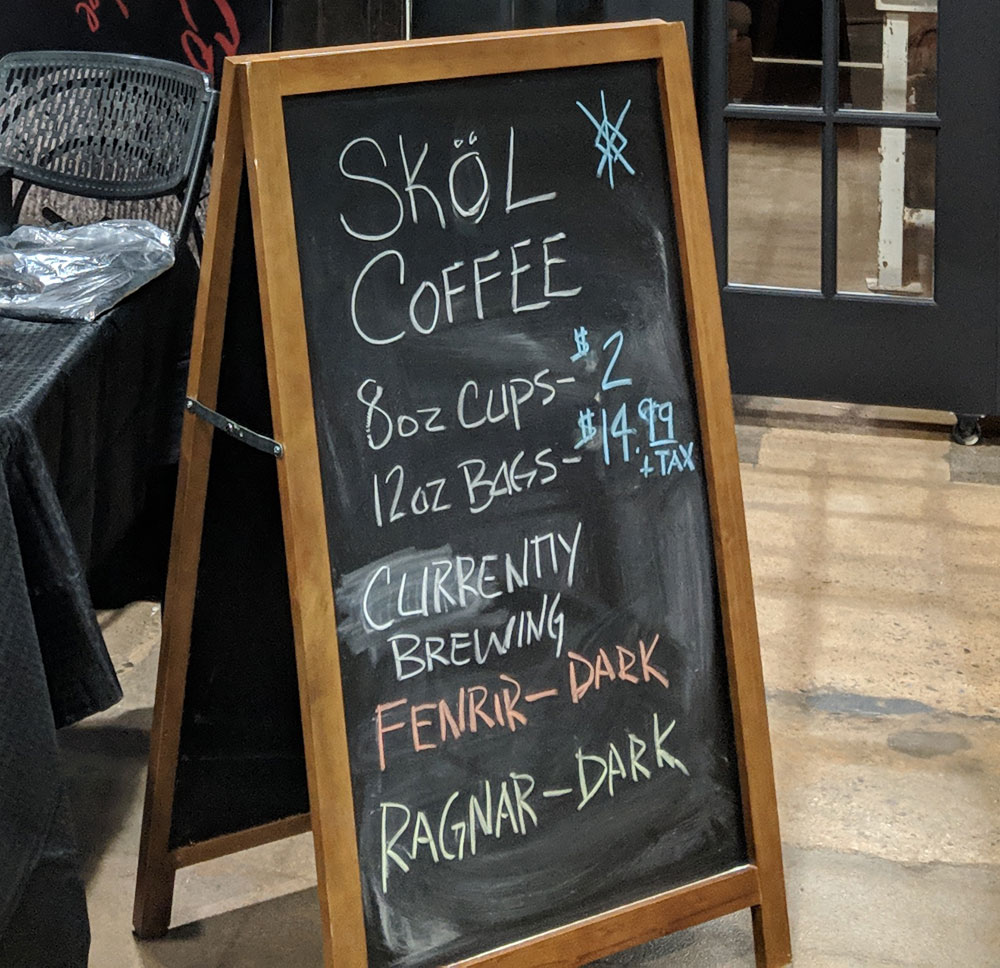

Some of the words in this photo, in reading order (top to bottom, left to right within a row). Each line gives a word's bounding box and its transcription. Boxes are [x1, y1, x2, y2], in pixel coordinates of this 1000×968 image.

[338, 126, 557, 242] SKÖL
[351, 232, 583, 345] COFFEE
[387, 592, 566, 682] BREWING
[568, 633, 669, 704] DARK
[575, 712, 690, 812] DARK
